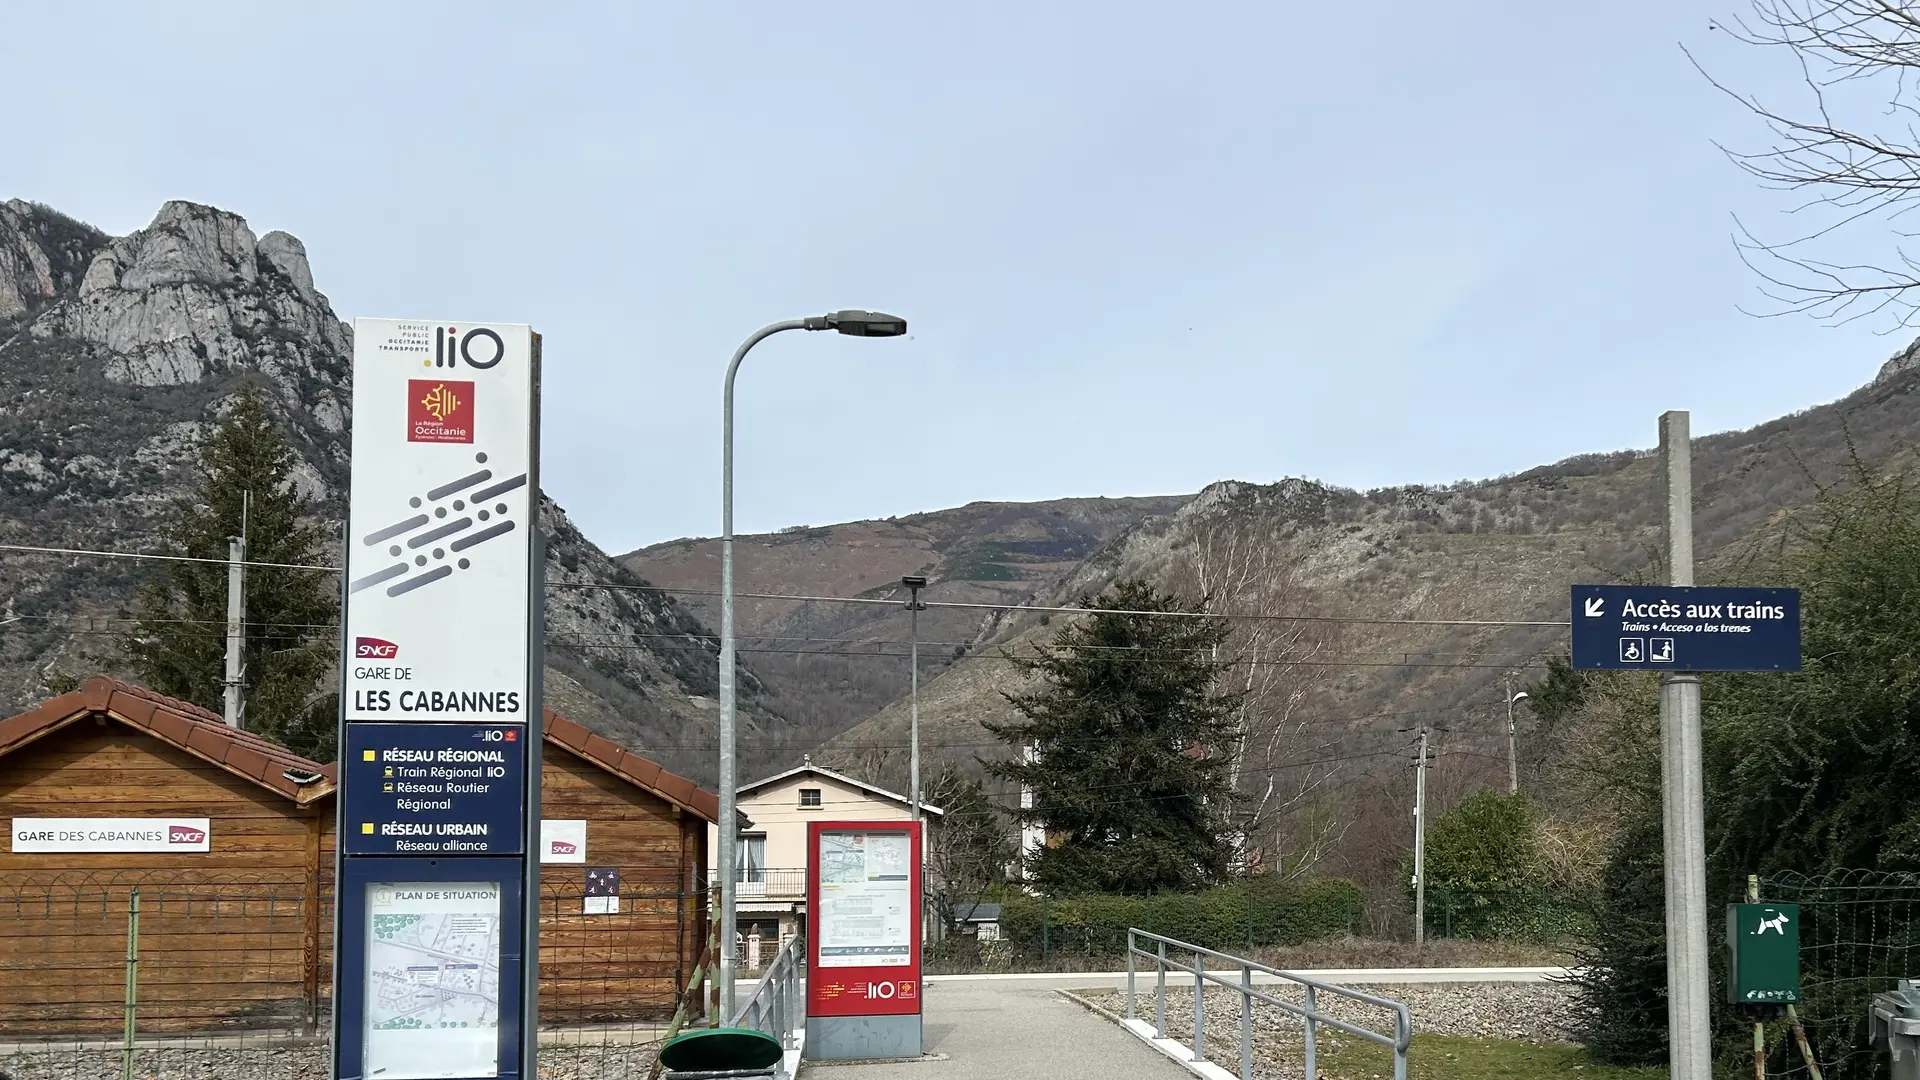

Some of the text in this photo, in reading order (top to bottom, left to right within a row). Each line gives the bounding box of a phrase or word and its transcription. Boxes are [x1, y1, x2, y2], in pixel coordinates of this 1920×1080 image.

[415, 426, 466, 436] Occitanie
[1622, 599, 1784, 619] Accès aux trains
[1621, 622, 1650, 632] Trains
[1659, 622, 1694, 633] Acceso
[1704, 623, 1719, 633] los
[1720, 624, 1751, 633] trenes
[357, 645, 397, 656] SNCF
[355, 667, 412, 680] GARE DE
[355, 690, 520, 713] LES CABANNES
[383, 747, 505, 763] RÉSEAU RÉGIONAL
[398, 767, 505, 780] Train Régional liO
[397, 782, 489, 793] Réseau Routier
[397, 799, 451, 812] Régional
[382, 821, 487, 836] RÉSEAU URBAIN
[18, 831, 162, 841] GARE DES CABANNES
[170, 833, 203, 841] SNCF
[396, 840, 488, 850] Réseau alliance
[395, 891, 497, 900] PLAN DE SITUATION
